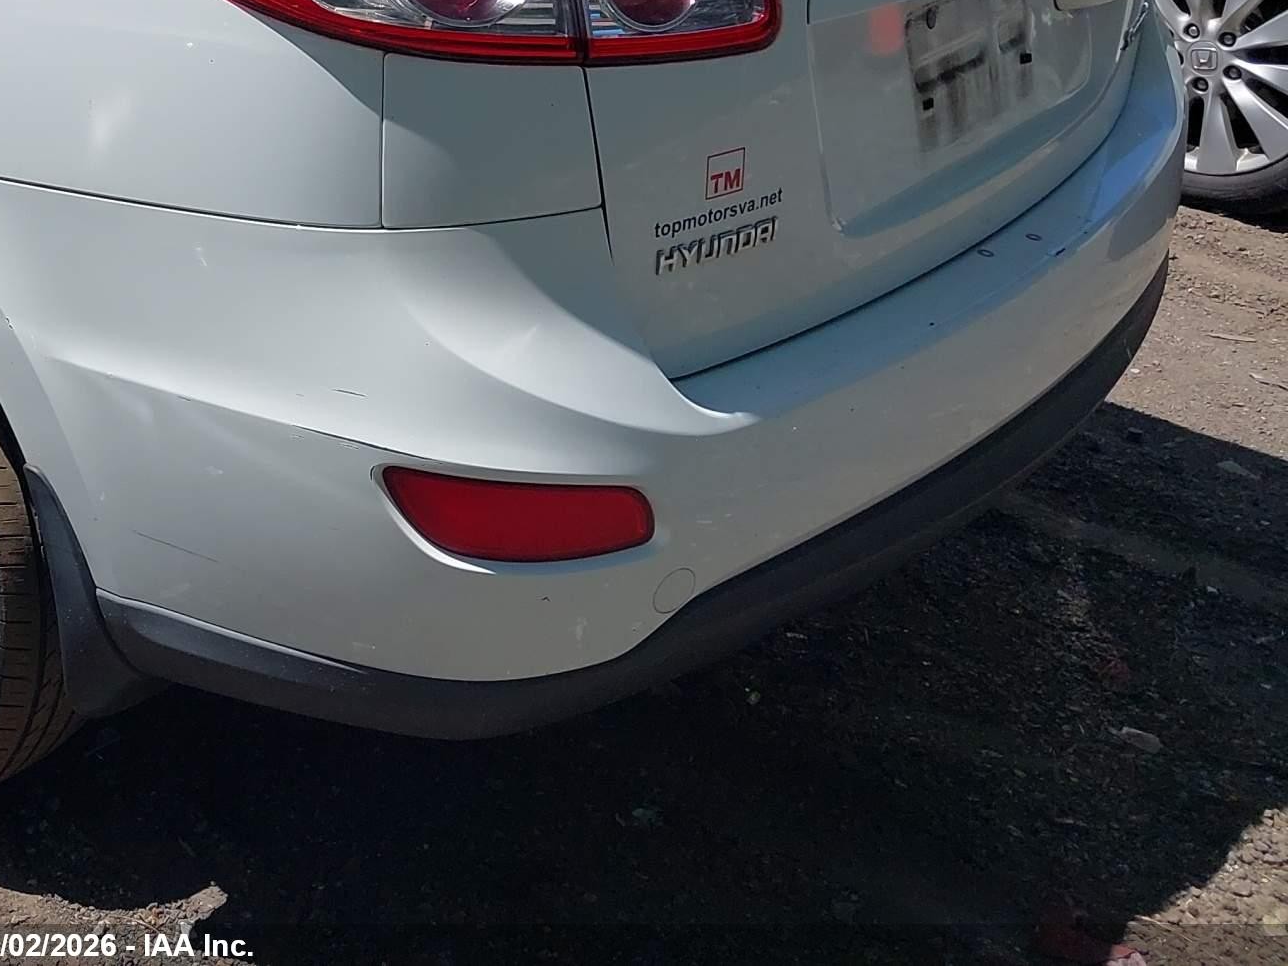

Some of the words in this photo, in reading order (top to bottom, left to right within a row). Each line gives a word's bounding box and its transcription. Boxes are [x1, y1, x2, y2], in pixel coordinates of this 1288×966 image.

[710, 168, 742, 194] TM
[654, 187, 784, 239] topmotorsva.net
[655, 215, 779, 276] HYUNDAI
